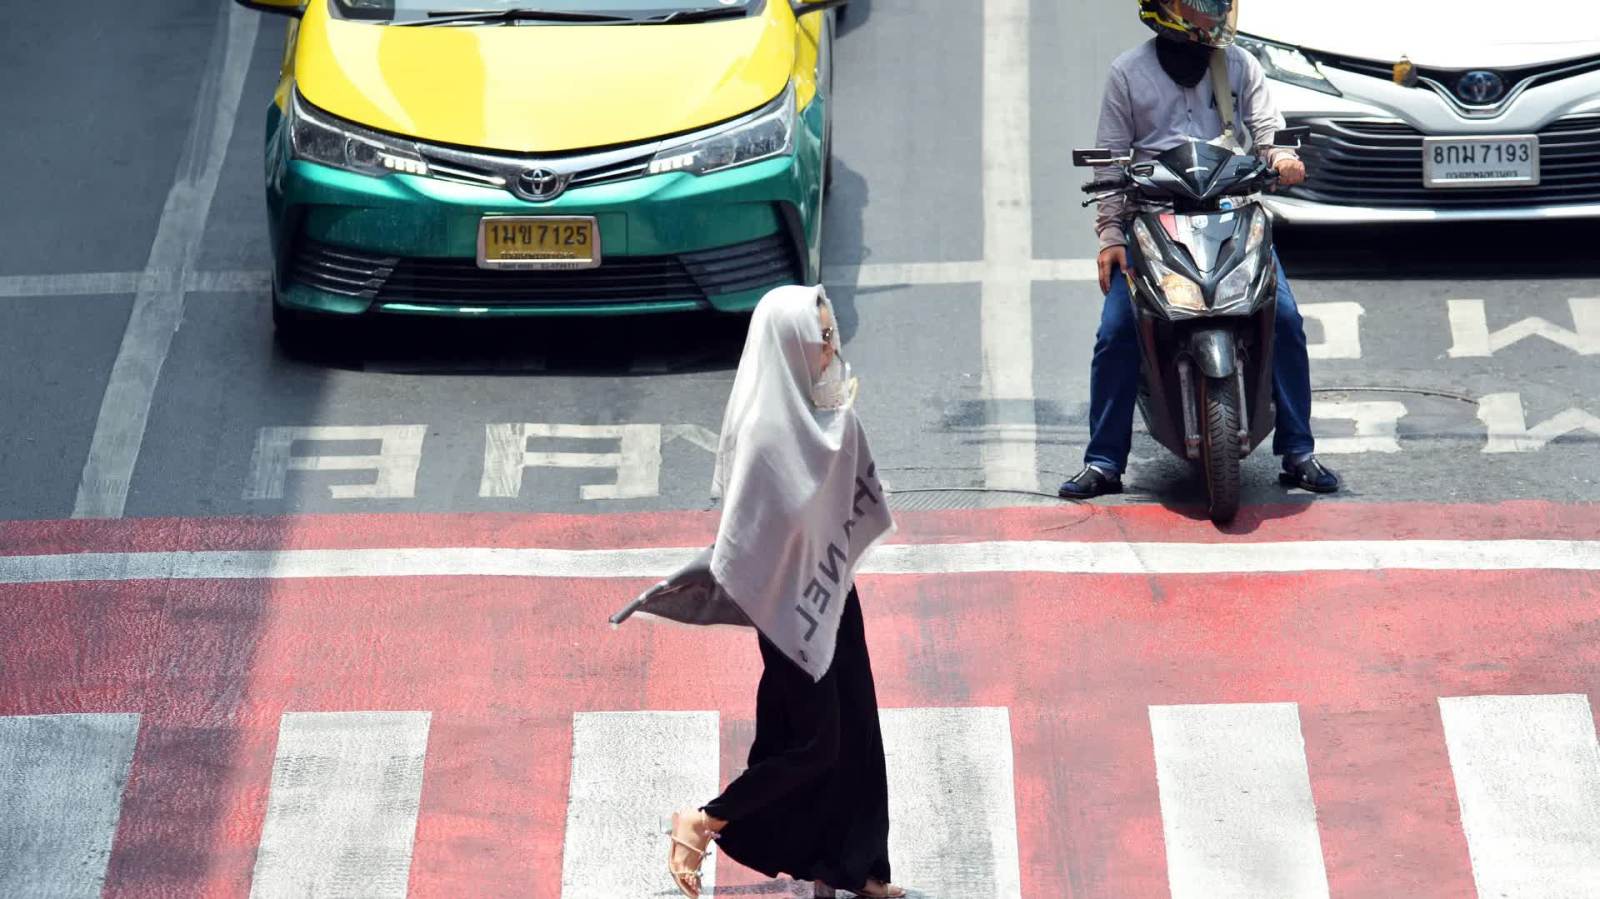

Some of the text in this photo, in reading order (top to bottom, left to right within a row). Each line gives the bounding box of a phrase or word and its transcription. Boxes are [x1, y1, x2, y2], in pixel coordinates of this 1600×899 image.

[1433, 143, 1530, 164] 8กม 7193
[537, 224, 588, 245] 7125
